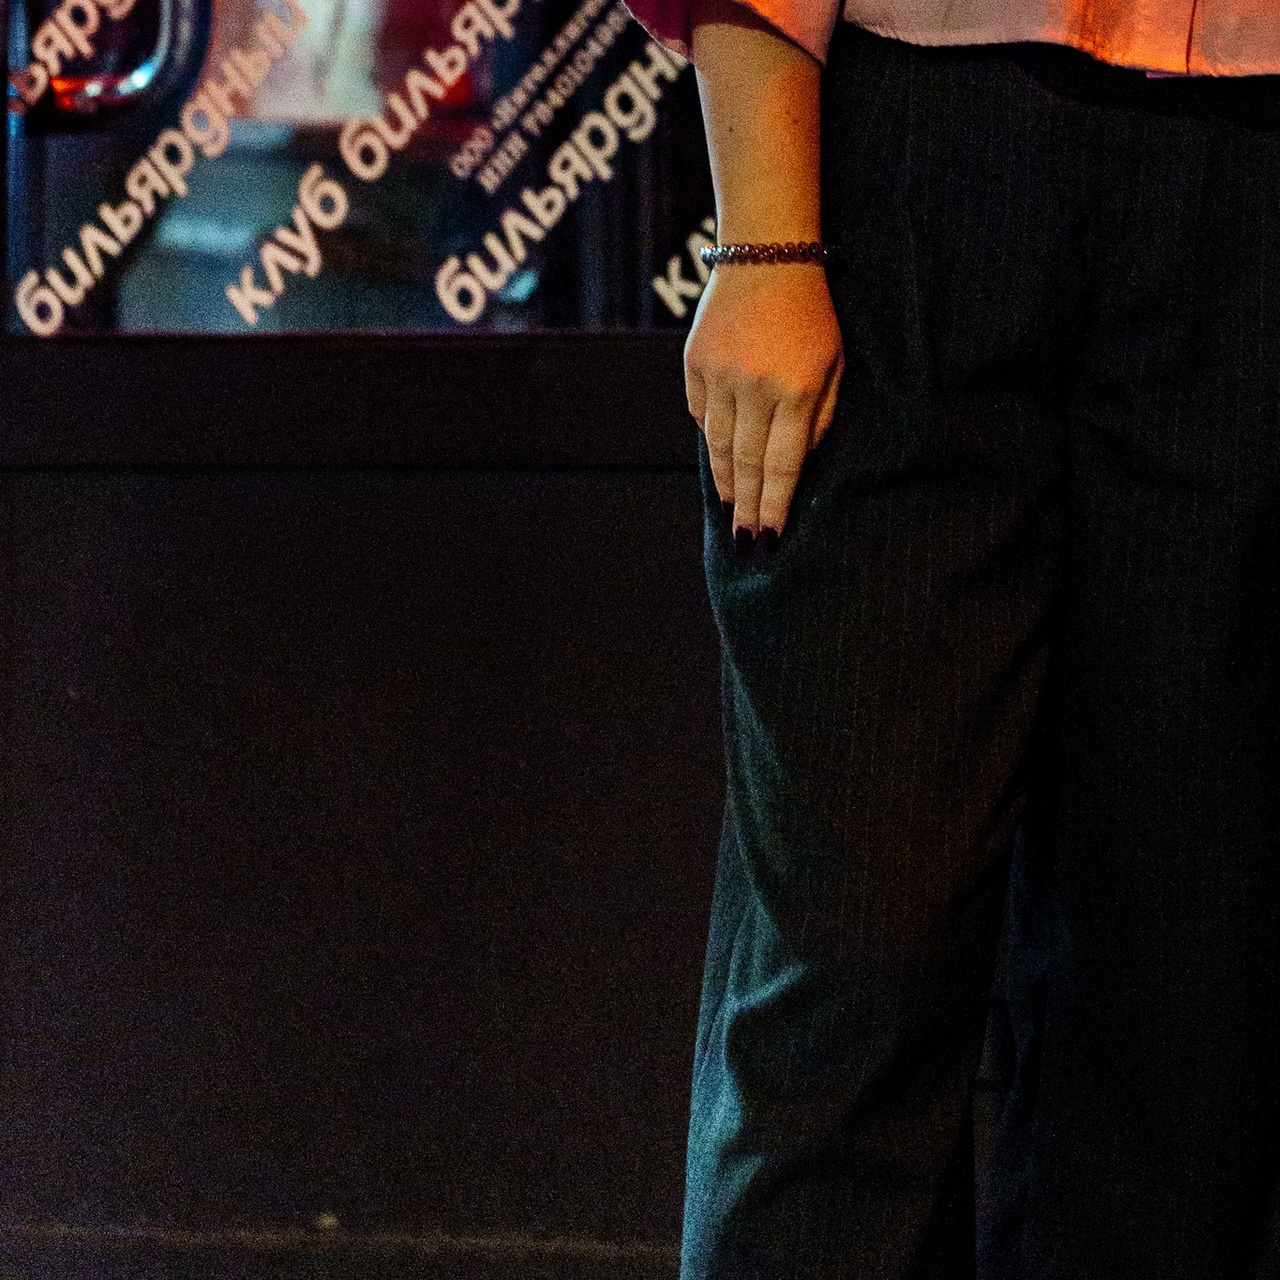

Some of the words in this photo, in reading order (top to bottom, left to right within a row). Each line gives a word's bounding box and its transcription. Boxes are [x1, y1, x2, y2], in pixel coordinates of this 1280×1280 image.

[434, 40, 688, 324] бильярдн
[451, 125, 495, 178] ООО
[225, 164, 349, 326] клуб
[652, 216, 718, 318] кл
